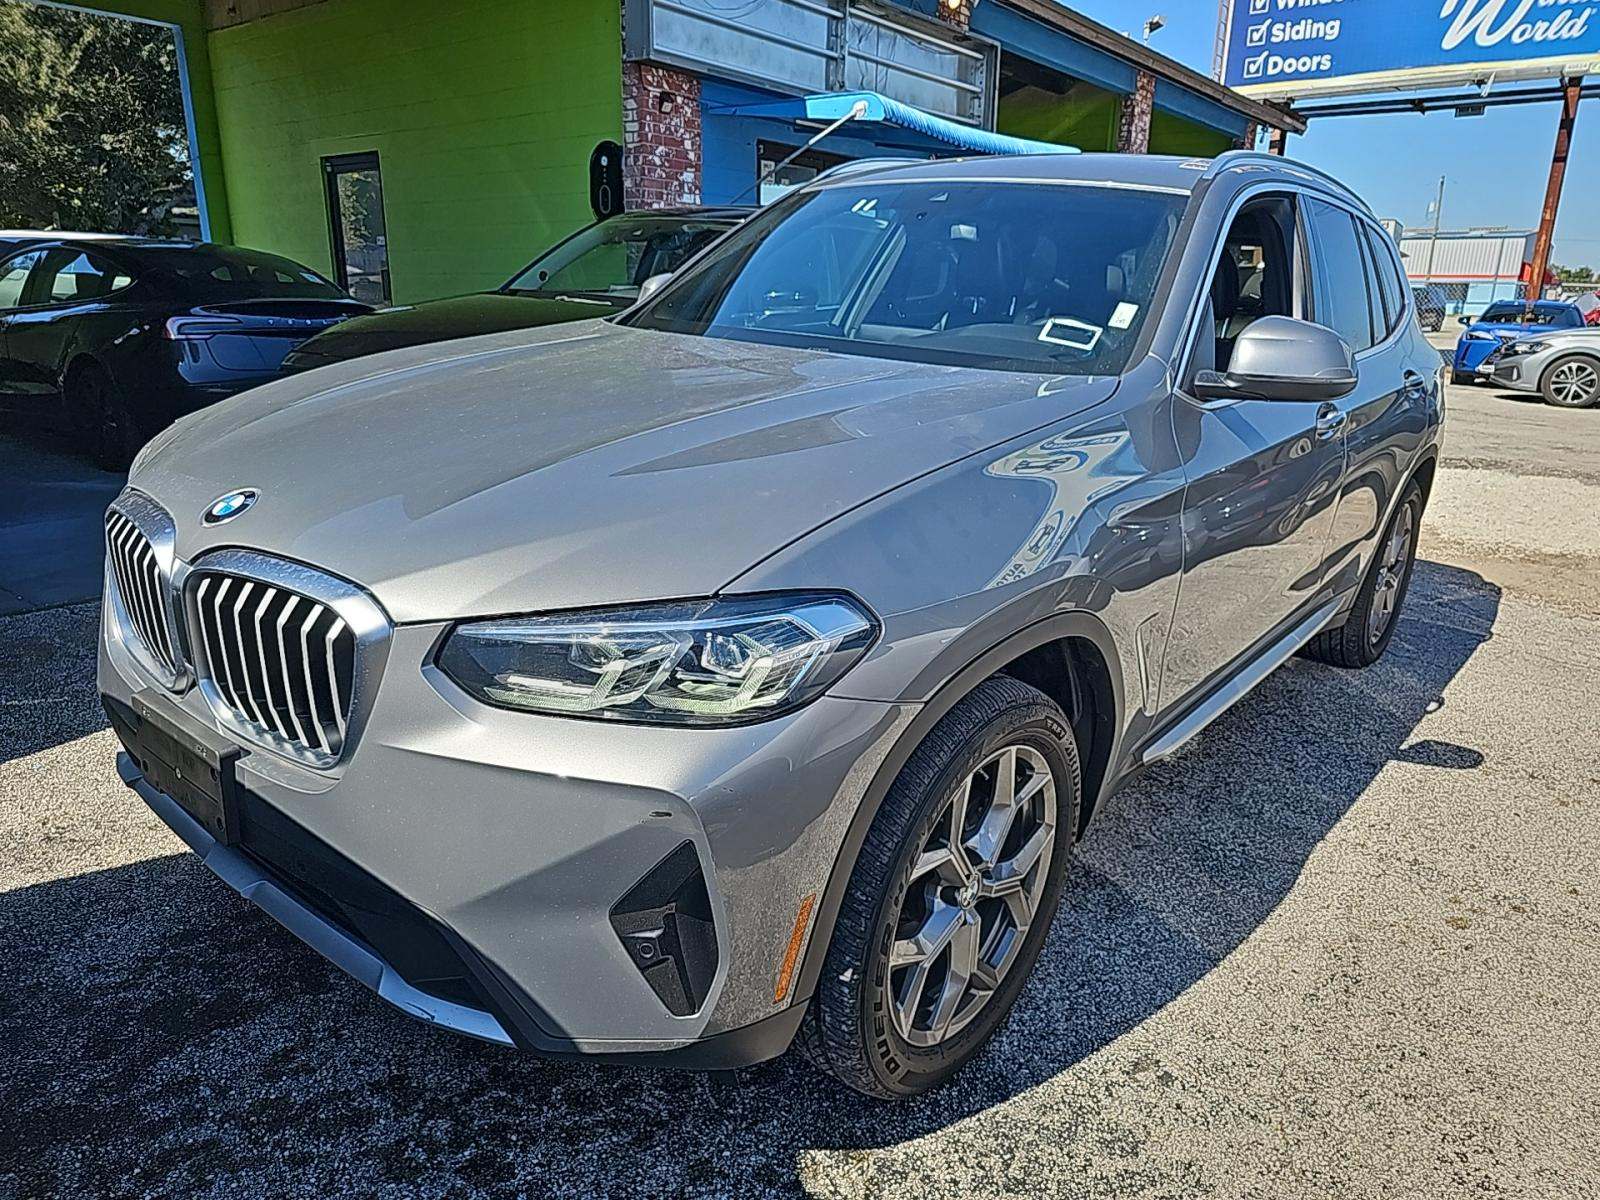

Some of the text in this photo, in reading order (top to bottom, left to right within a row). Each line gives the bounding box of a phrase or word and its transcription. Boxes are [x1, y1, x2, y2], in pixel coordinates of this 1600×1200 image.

[1271, 19, 1341, 43] Siding
[1440, 0, 1592, 50] World
[1267, 54, 1332, 76] Doors
[874, 922, 901, 1075] DUELER
